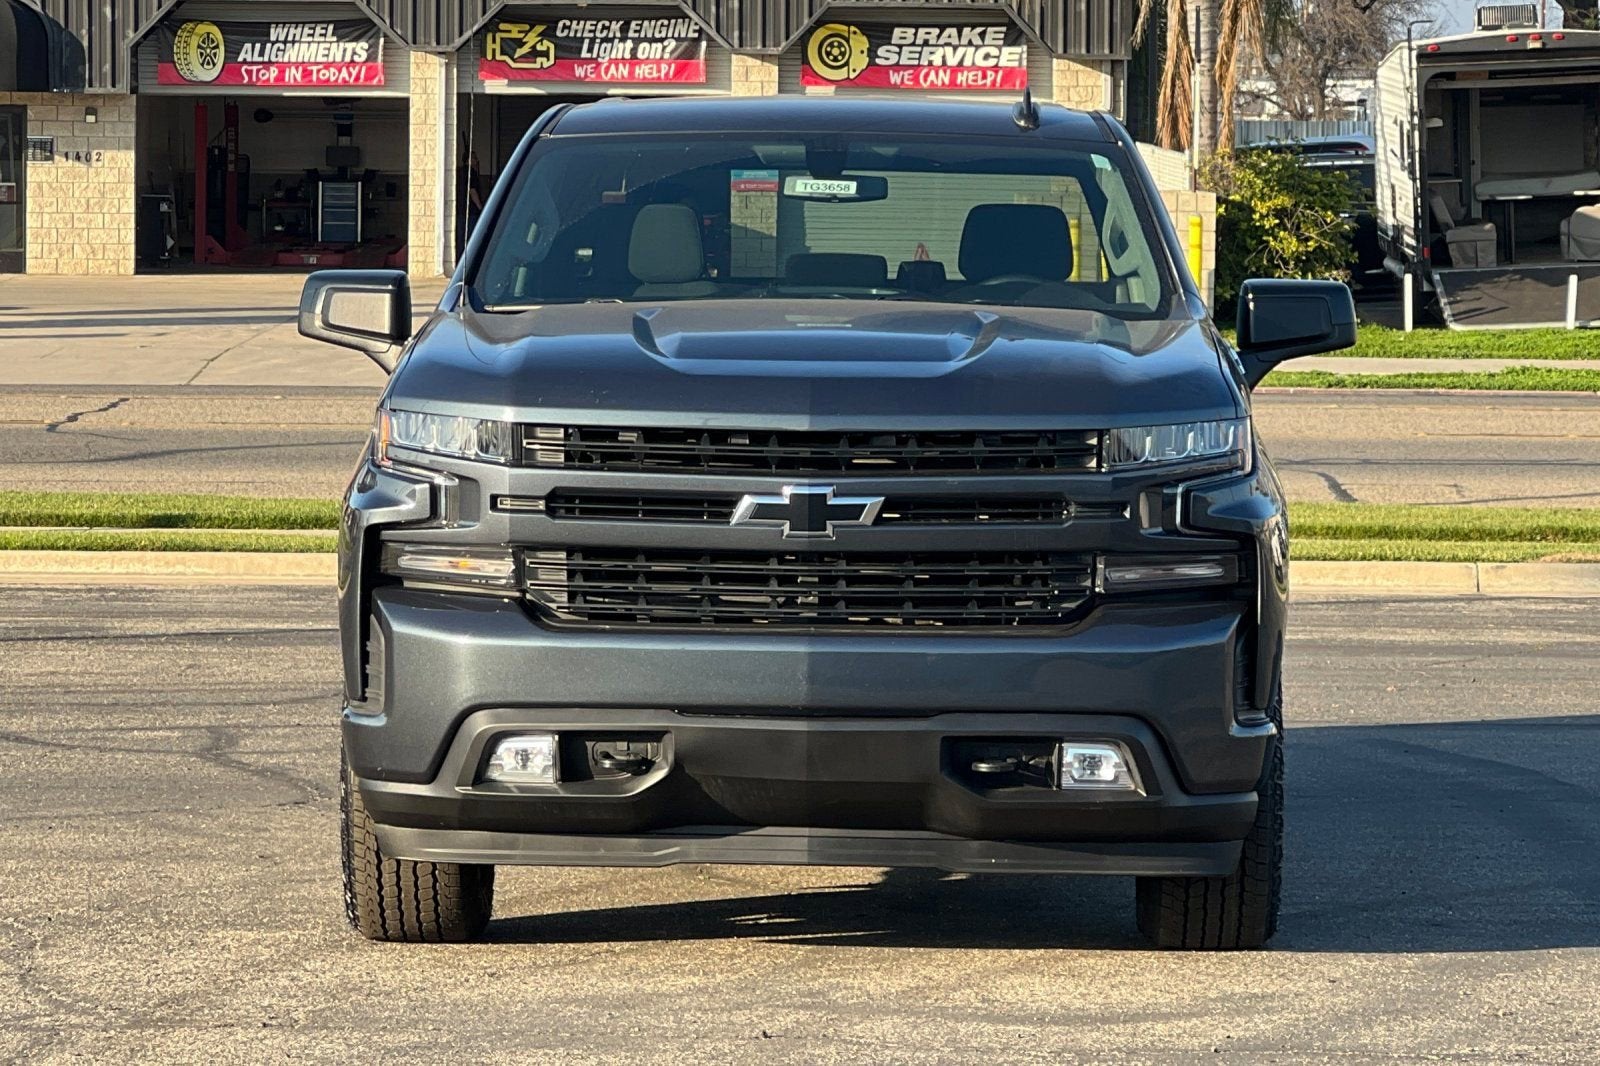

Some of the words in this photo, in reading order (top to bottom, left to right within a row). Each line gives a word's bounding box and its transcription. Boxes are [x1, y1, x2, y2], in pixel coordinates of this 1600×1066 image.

[269, 23, 337, 42] WHEEL
[556, 19, 623, 38] CHECK
[628, 18, 700, 38] ENGINE
[891, 26, 1007, 45] BRAKE
[237, 42, 369, 63] ALIGNMENTS
[580, 38, 632, 63] Light
[636, 38, 676, 59] on?
[875, 45, 1022, 67] SERVICE
[240, 65, 278, 83] STOP
[285, 66, 303, 83] IN
[574, 64, 596, 79] WE
[600, 63, 630, 80] CAN
[634, 63, 675, 79] HELP!
[889, 70, 914, 86] WE
[919, 69, 950, 86] CAN
[957, 70, 1003, 87] HELP!
[64, 151, 102, 163] 1402
[801, 181, 850, 193] TG3658
